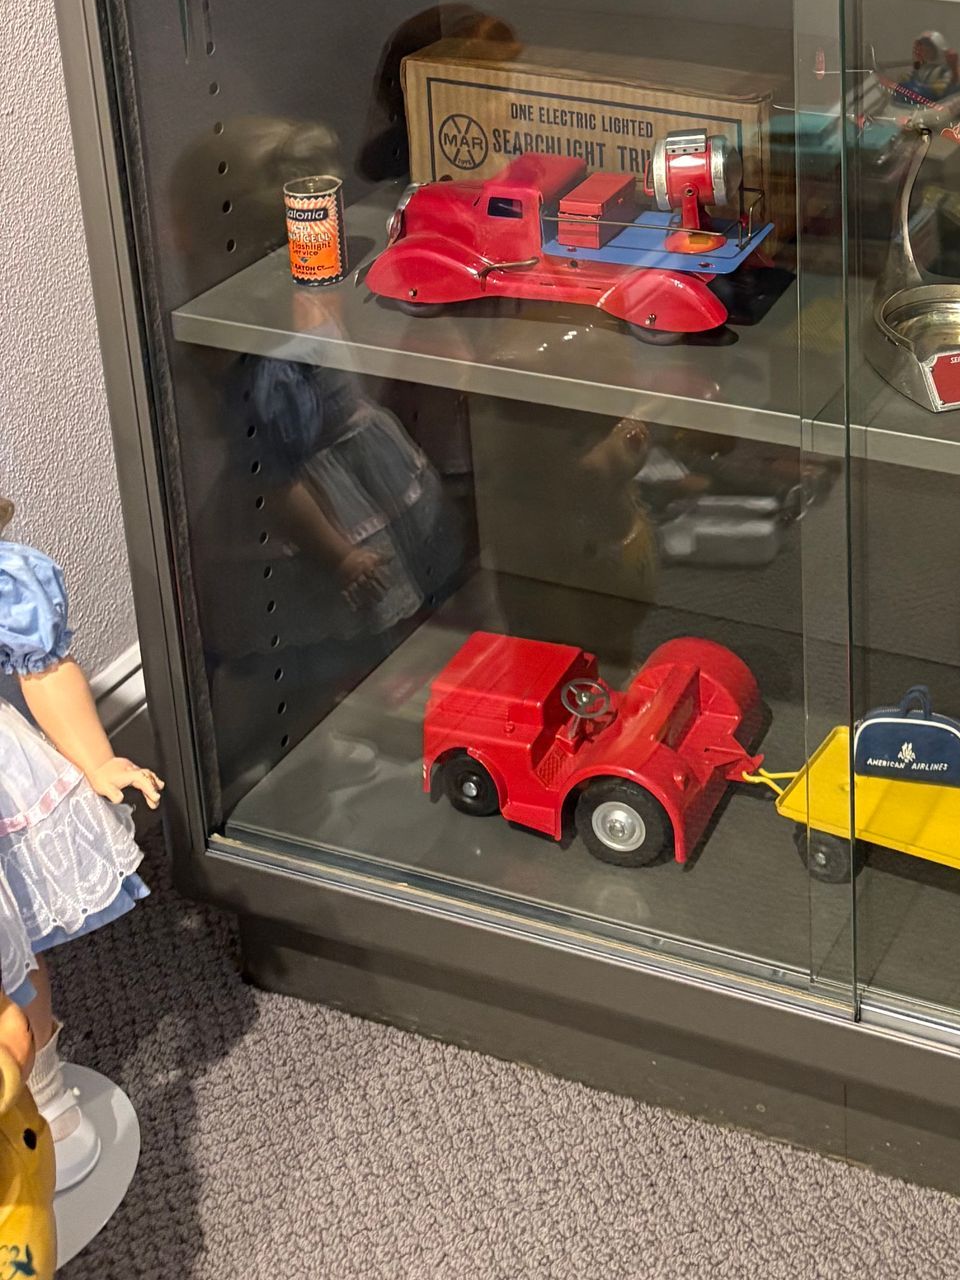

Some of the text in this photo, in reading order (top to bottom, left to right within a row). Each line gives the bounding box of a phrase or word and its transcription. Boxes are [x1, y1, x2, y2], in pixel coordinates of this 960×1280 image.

[510, 102, 654, 139] ONE ELECTRIC LIGHTED
[286, 208, 324, 221] atonia
[866, 757, 949, 771] AMERICAN AIRLINES
